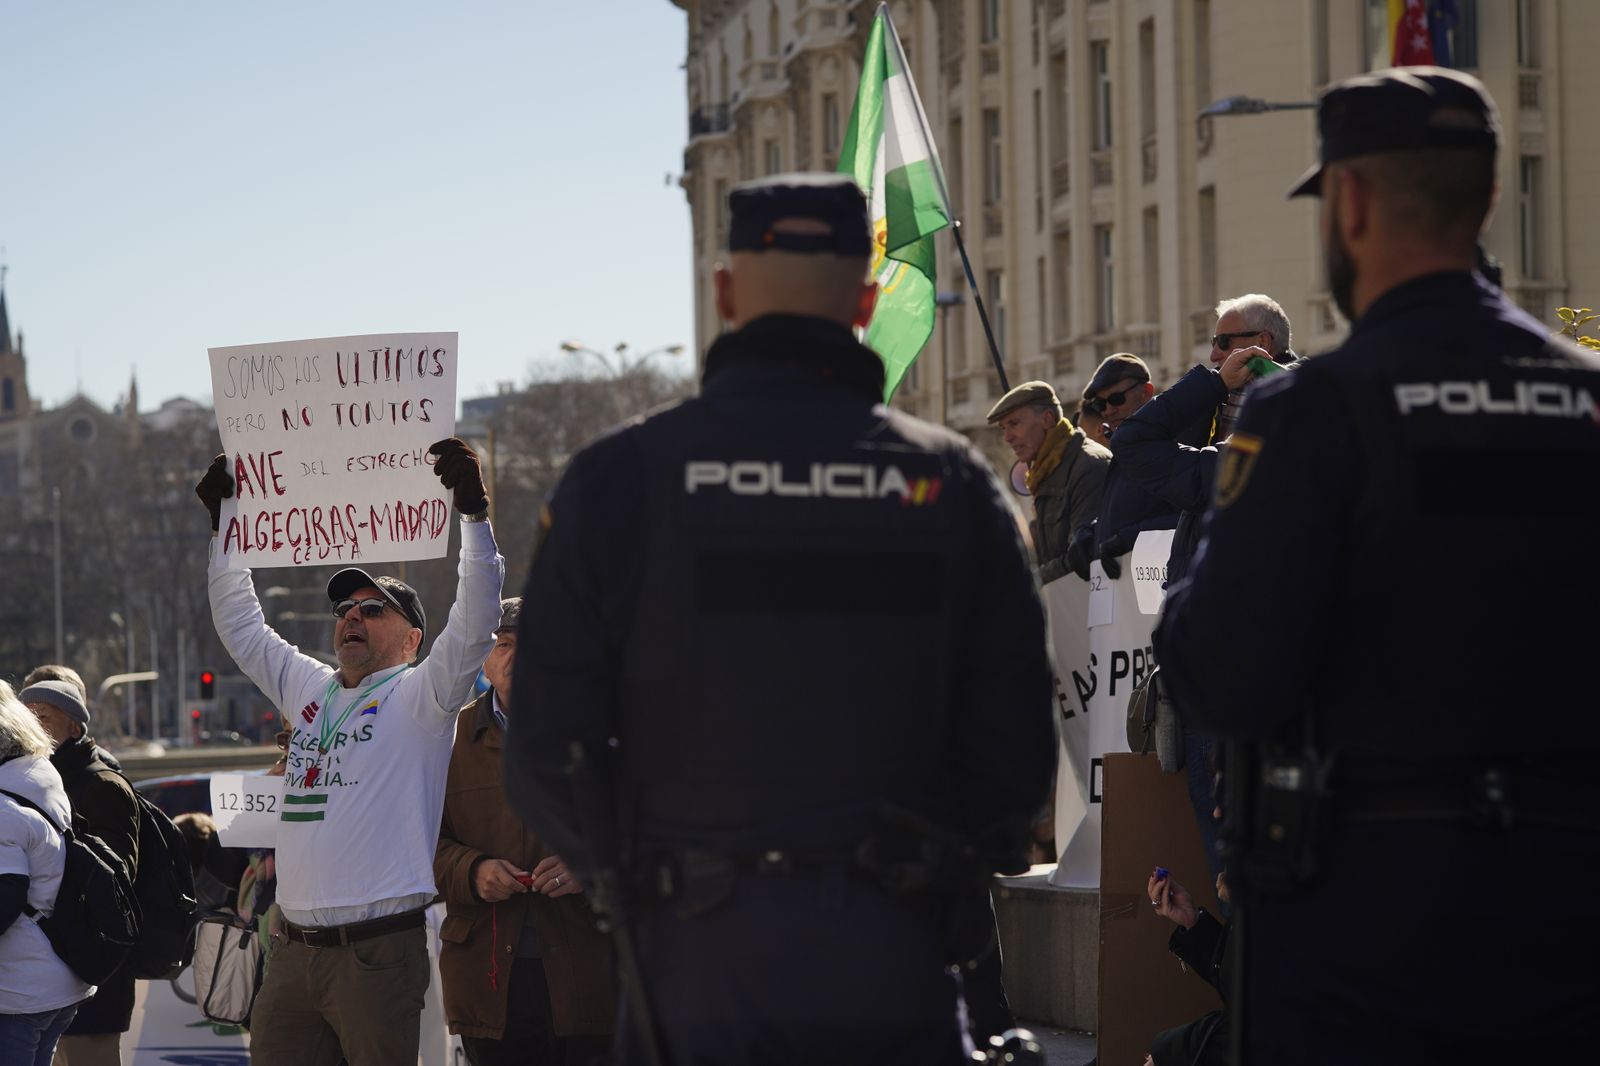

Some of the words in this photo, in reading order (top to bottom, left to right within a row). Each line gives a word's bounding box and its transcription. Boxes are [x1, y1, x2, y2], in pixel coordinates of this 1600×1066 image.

[223, 355, 285, 399] SOMOS
[294, 355, 321, 385] LOS
[336, 345, 446, 388] ULTIMOS
[226, 413, 266, 433] PERO
[281, 400, 314, 431] NO
[331, 398, 434, 430] TONTOS
[235, 450, 286, 499] AVE
[300, 460, 331, 476] DEL
[346, 447, 440, 472] ESTRECHO
[685, 461, 911, 498] POLICIA
[223, 498, 448, 555] ALGECIRAS-MADRID
[293, 545, 363, 565] CEUTA
